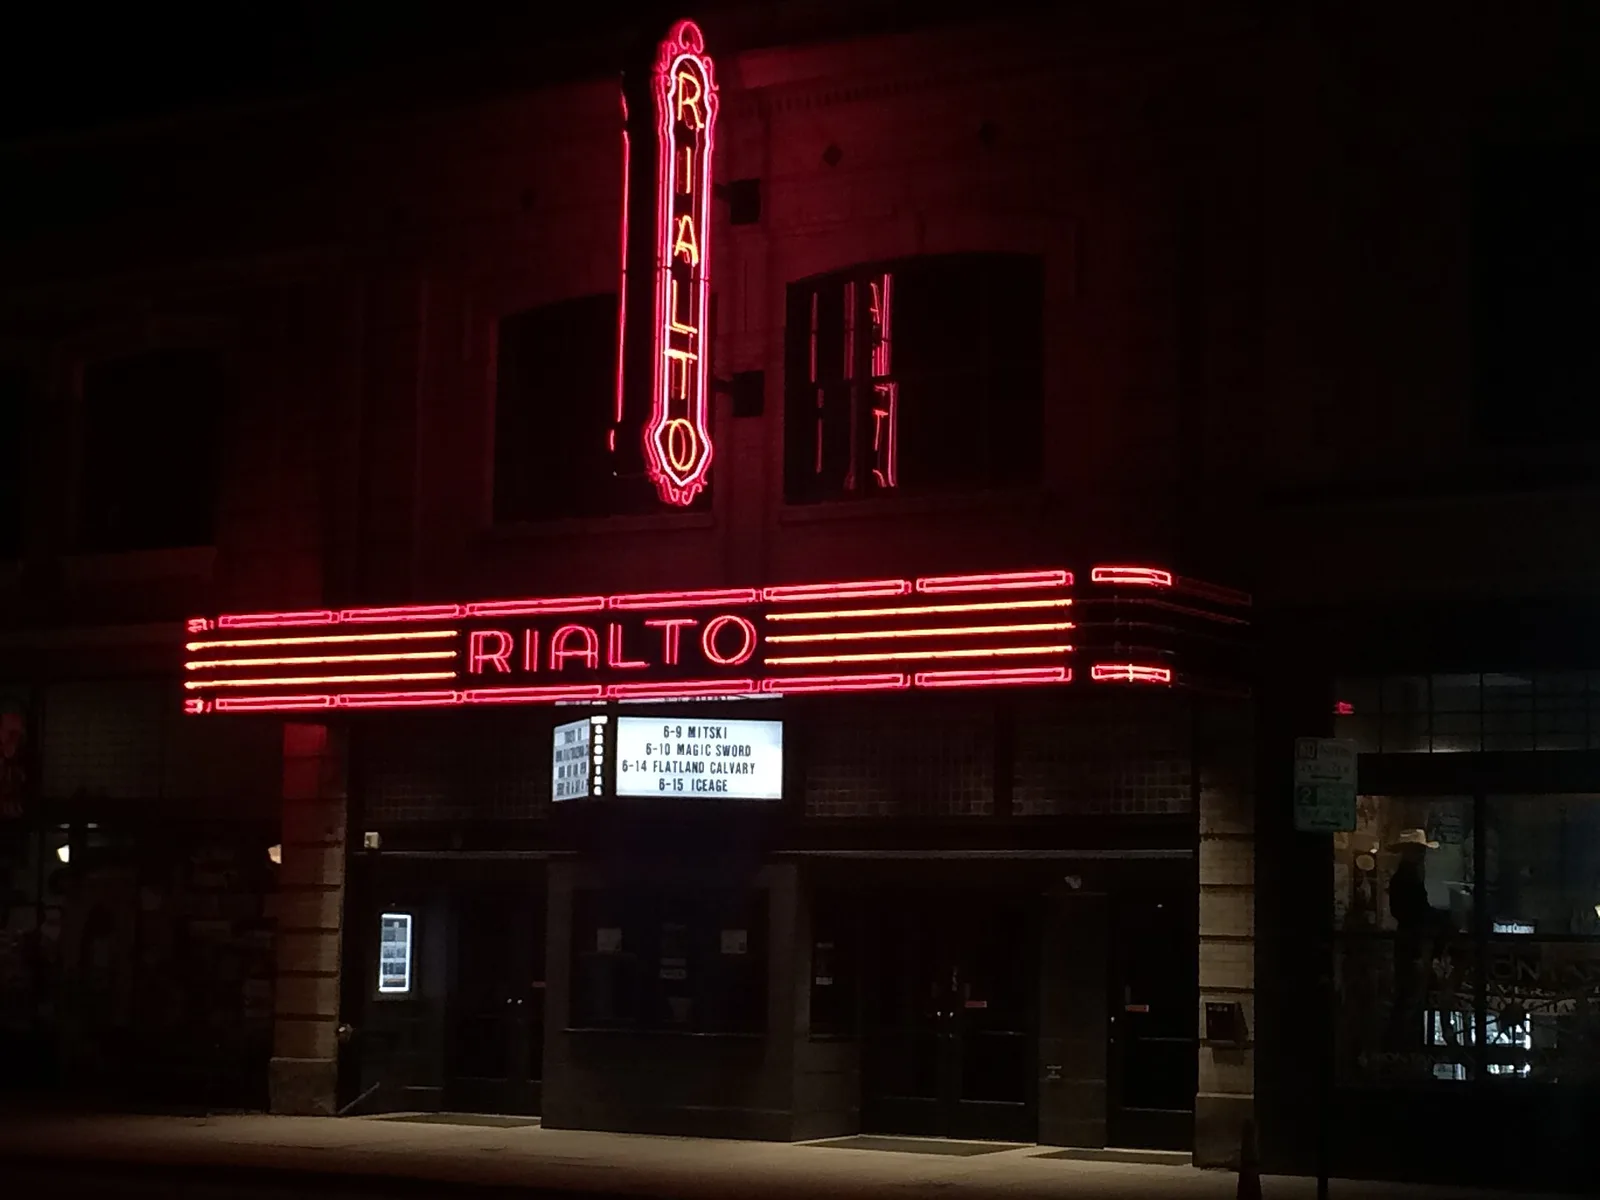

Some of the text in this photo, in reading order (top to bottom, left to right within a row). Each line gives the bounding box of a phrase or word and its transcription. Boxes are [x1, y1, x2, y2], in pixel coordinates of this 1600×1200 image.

[663, 71, 704, 472] RIALTO
[468, 614, 758, 674] RIALTO
[663, 725, 727, 739] 6-9 MITSKI
[646, 743, 751, 757] 6-10 MAGIC SWORD
[622, 760, 756, 775] 6-14 FLATLAND CALVARY
[659, 778, 728, 792] 6-15 ICEAGE
